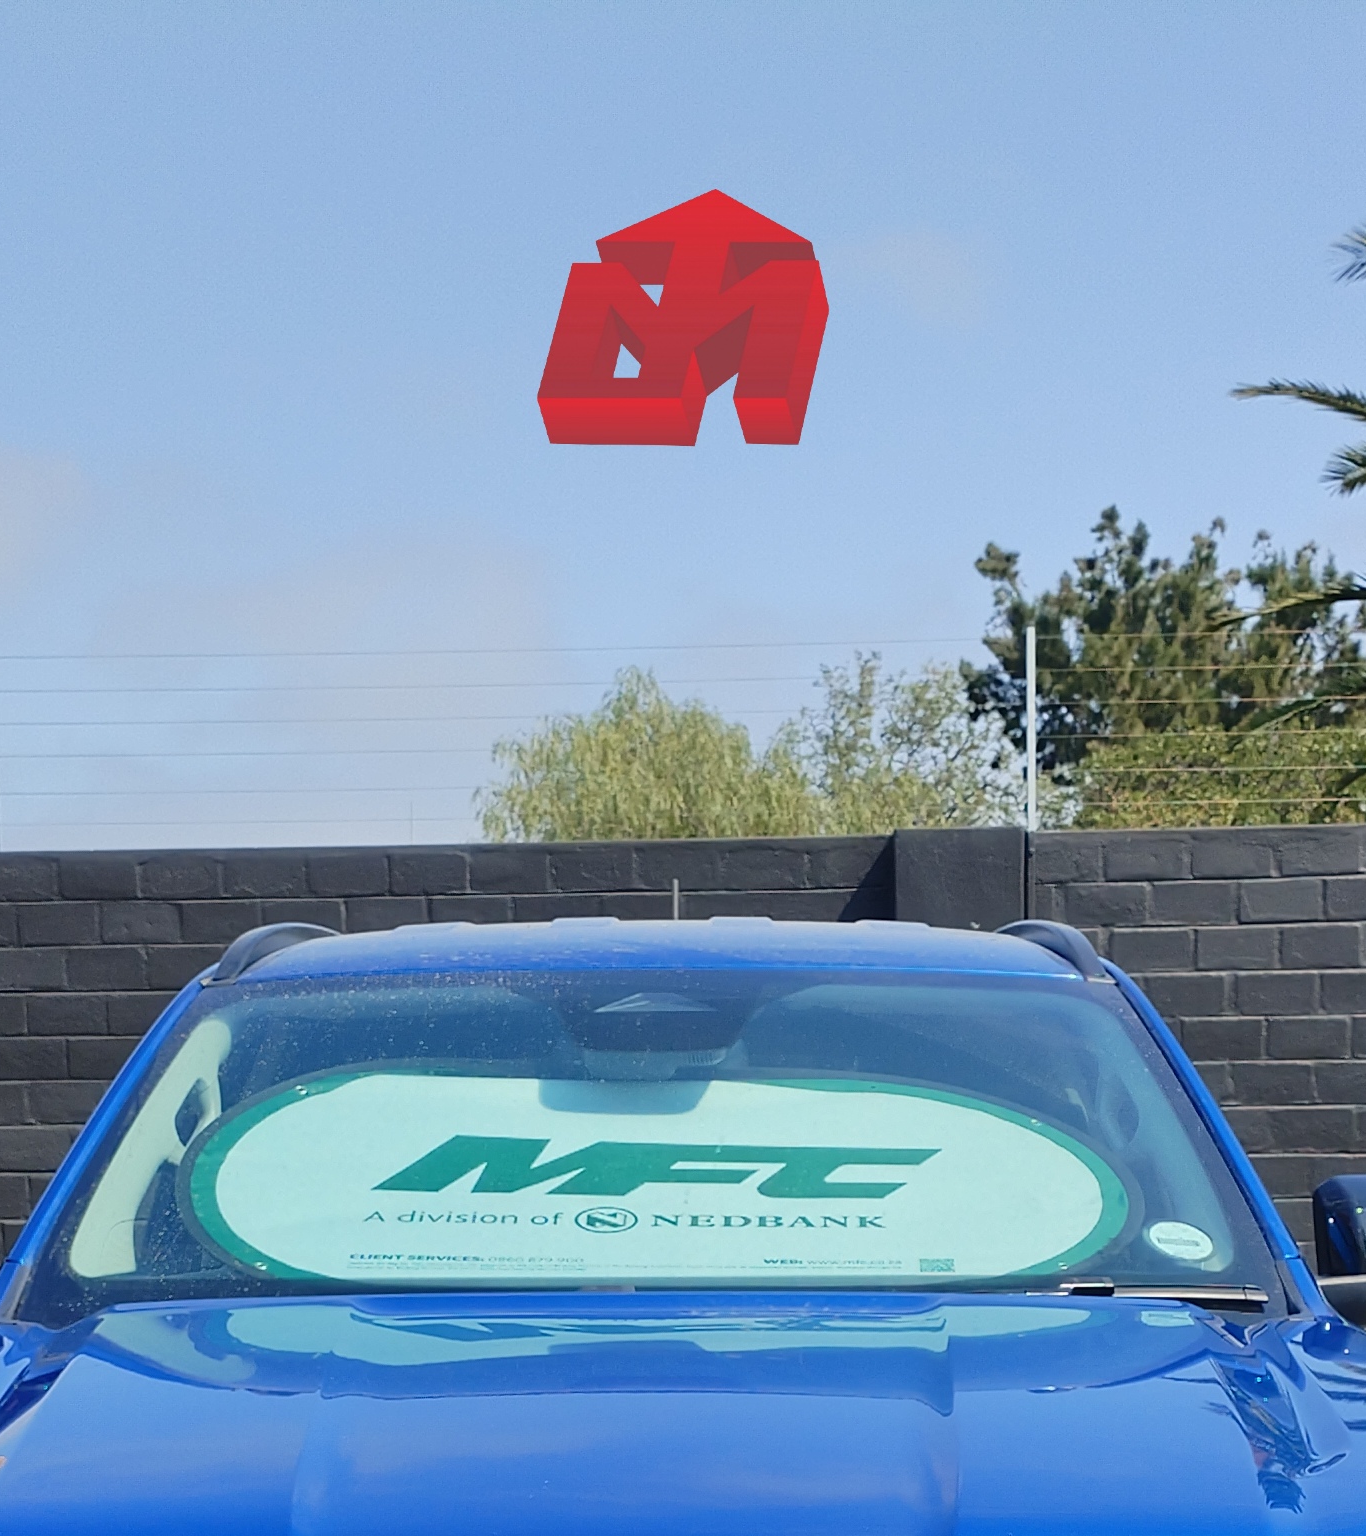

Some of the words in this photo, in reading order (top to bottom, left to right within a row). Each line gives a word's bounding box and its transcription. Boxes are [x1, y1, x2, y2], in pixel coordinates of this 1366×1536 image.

[371, 1135, 942, 1199] MFC
[363, 1211, 385, 1223] A
[397, 1210, 518, 1224] division
[530, 1212, 563, 1226] of
[651, 1214, 887, 1229] NEDBANK
[349, 1253, 405, 1261] CLIENT
